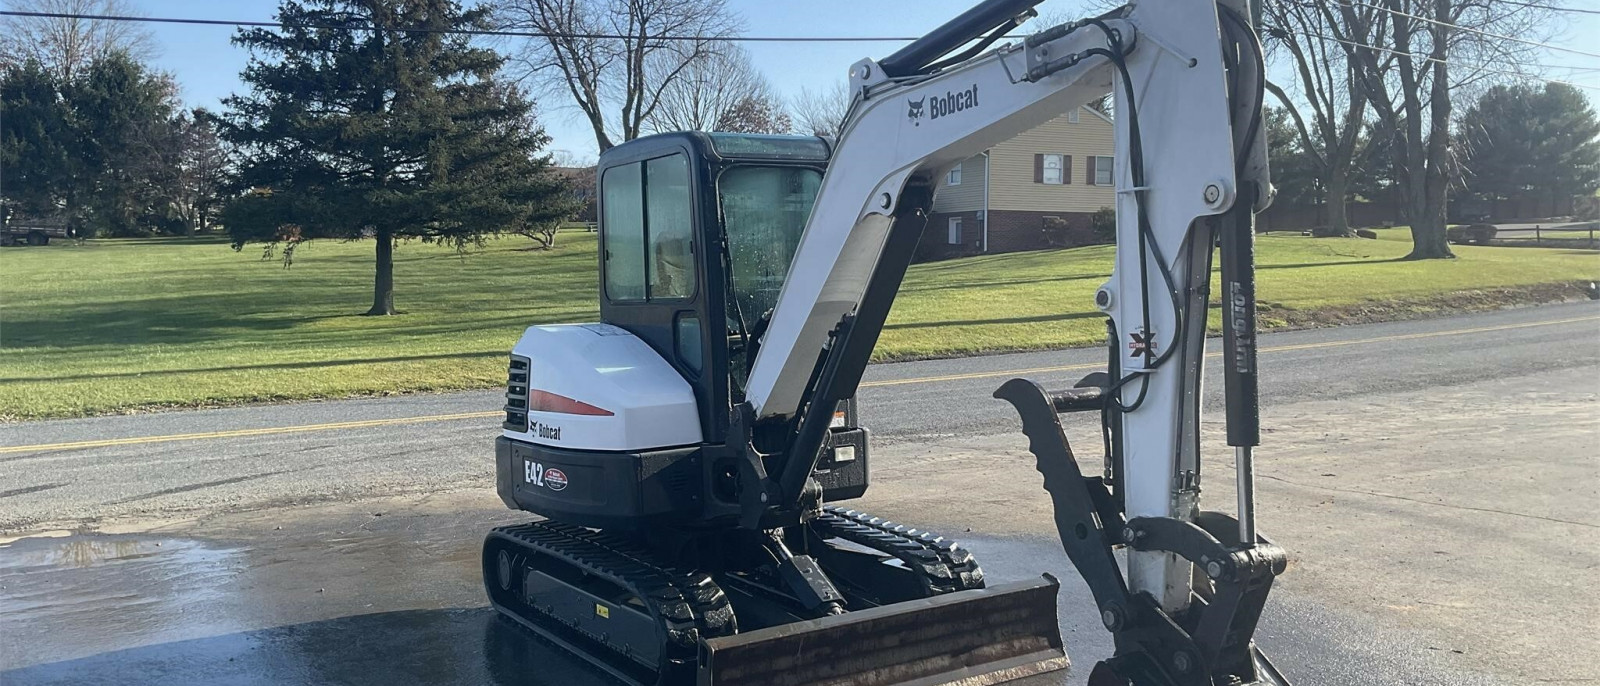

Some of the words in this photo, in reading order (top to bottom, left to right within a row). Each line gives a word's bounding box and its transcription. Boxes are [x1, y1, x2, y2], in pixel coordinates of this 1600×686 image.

[929, 83, 979, 120] Bobcat
[538, 423, 561, 441] Bobcat
[524, 460, 544, 487] E42
